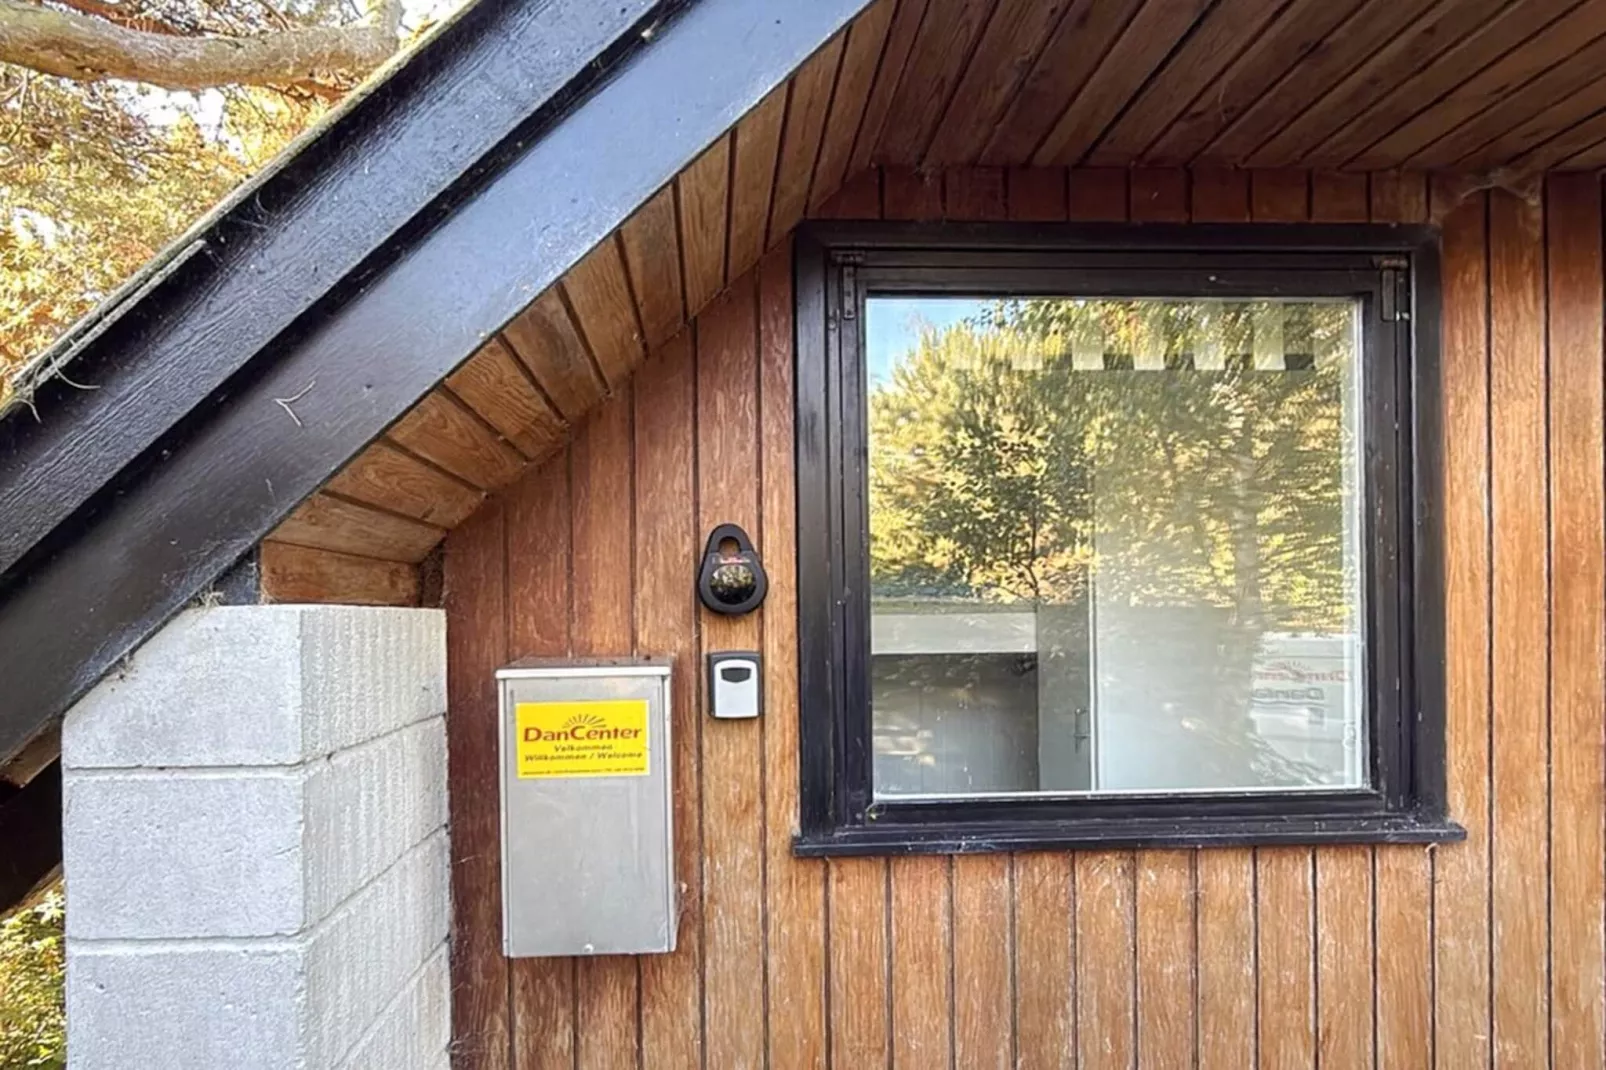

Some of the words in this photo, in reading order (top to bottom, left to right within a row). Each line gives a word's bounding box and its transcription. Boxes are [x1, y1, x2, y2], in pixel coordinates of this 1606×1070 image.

[523, 725, 642, 743] DanCenter
[554, 744, 613, 752] Velkommen
[524, 753, 587, 762] Willkommen
[597, 751, 643, 760] Welcome
